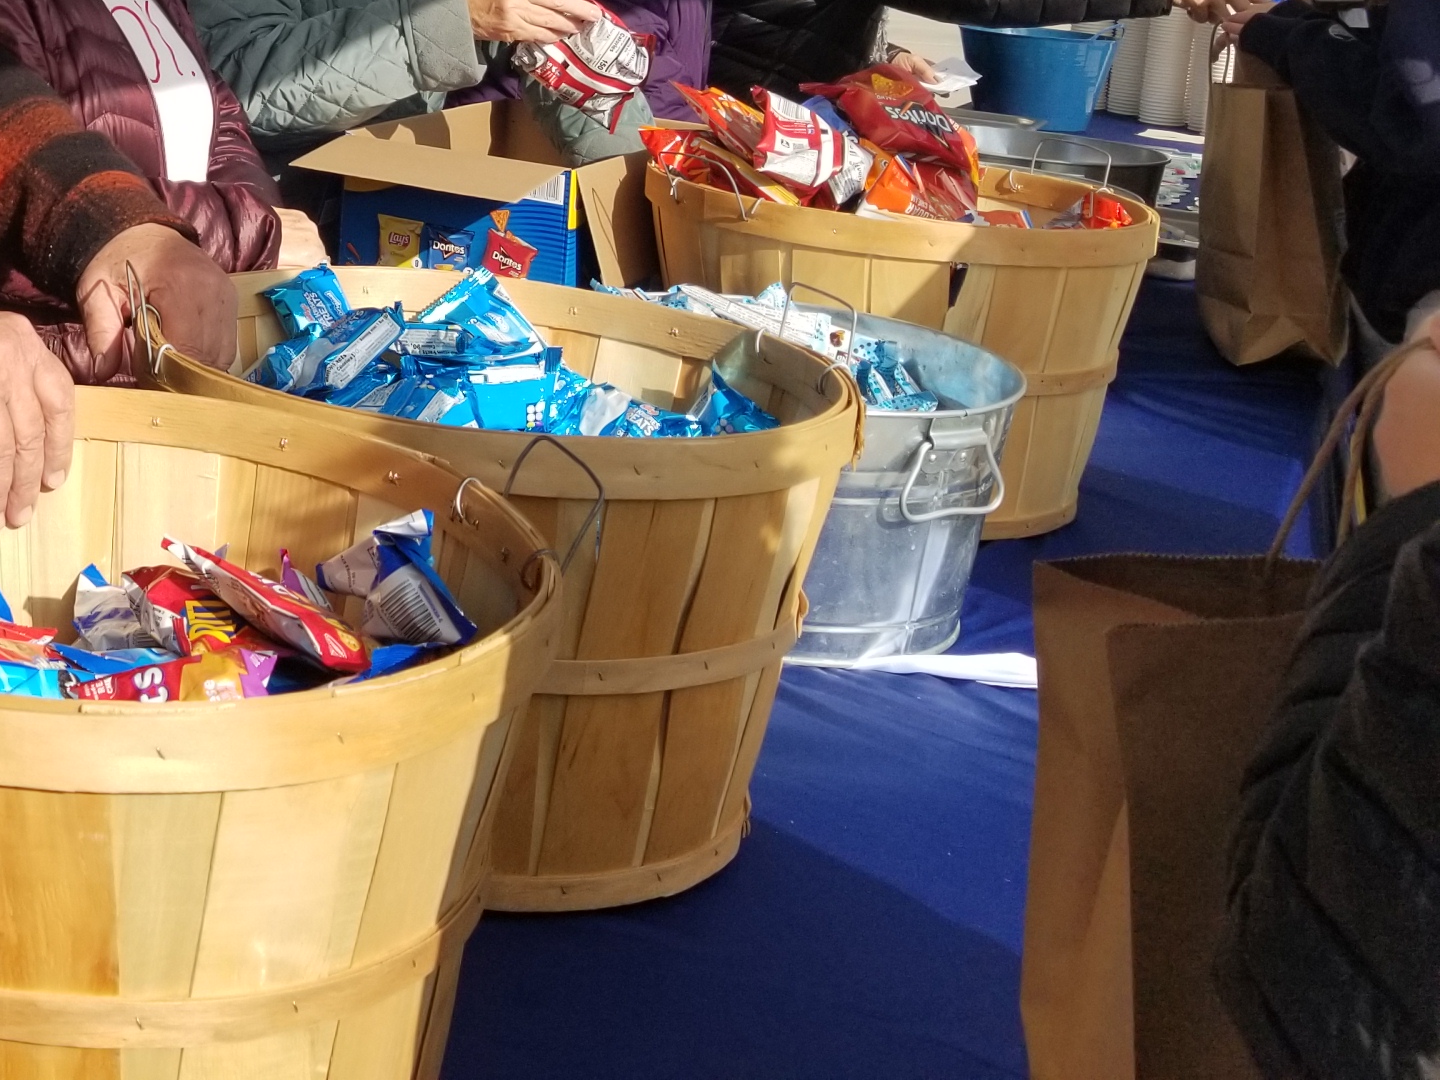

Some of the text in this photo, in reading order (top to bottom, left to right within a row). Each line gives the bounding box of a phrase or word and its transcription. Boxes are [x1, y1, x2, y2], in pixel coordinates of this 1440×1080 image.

[597, 59, 608, 71] 150
[884, 106, 953, 133] Doritos
[433, 241, 465, 255] Doritos
[492, 251, 522, 270] Doritos
